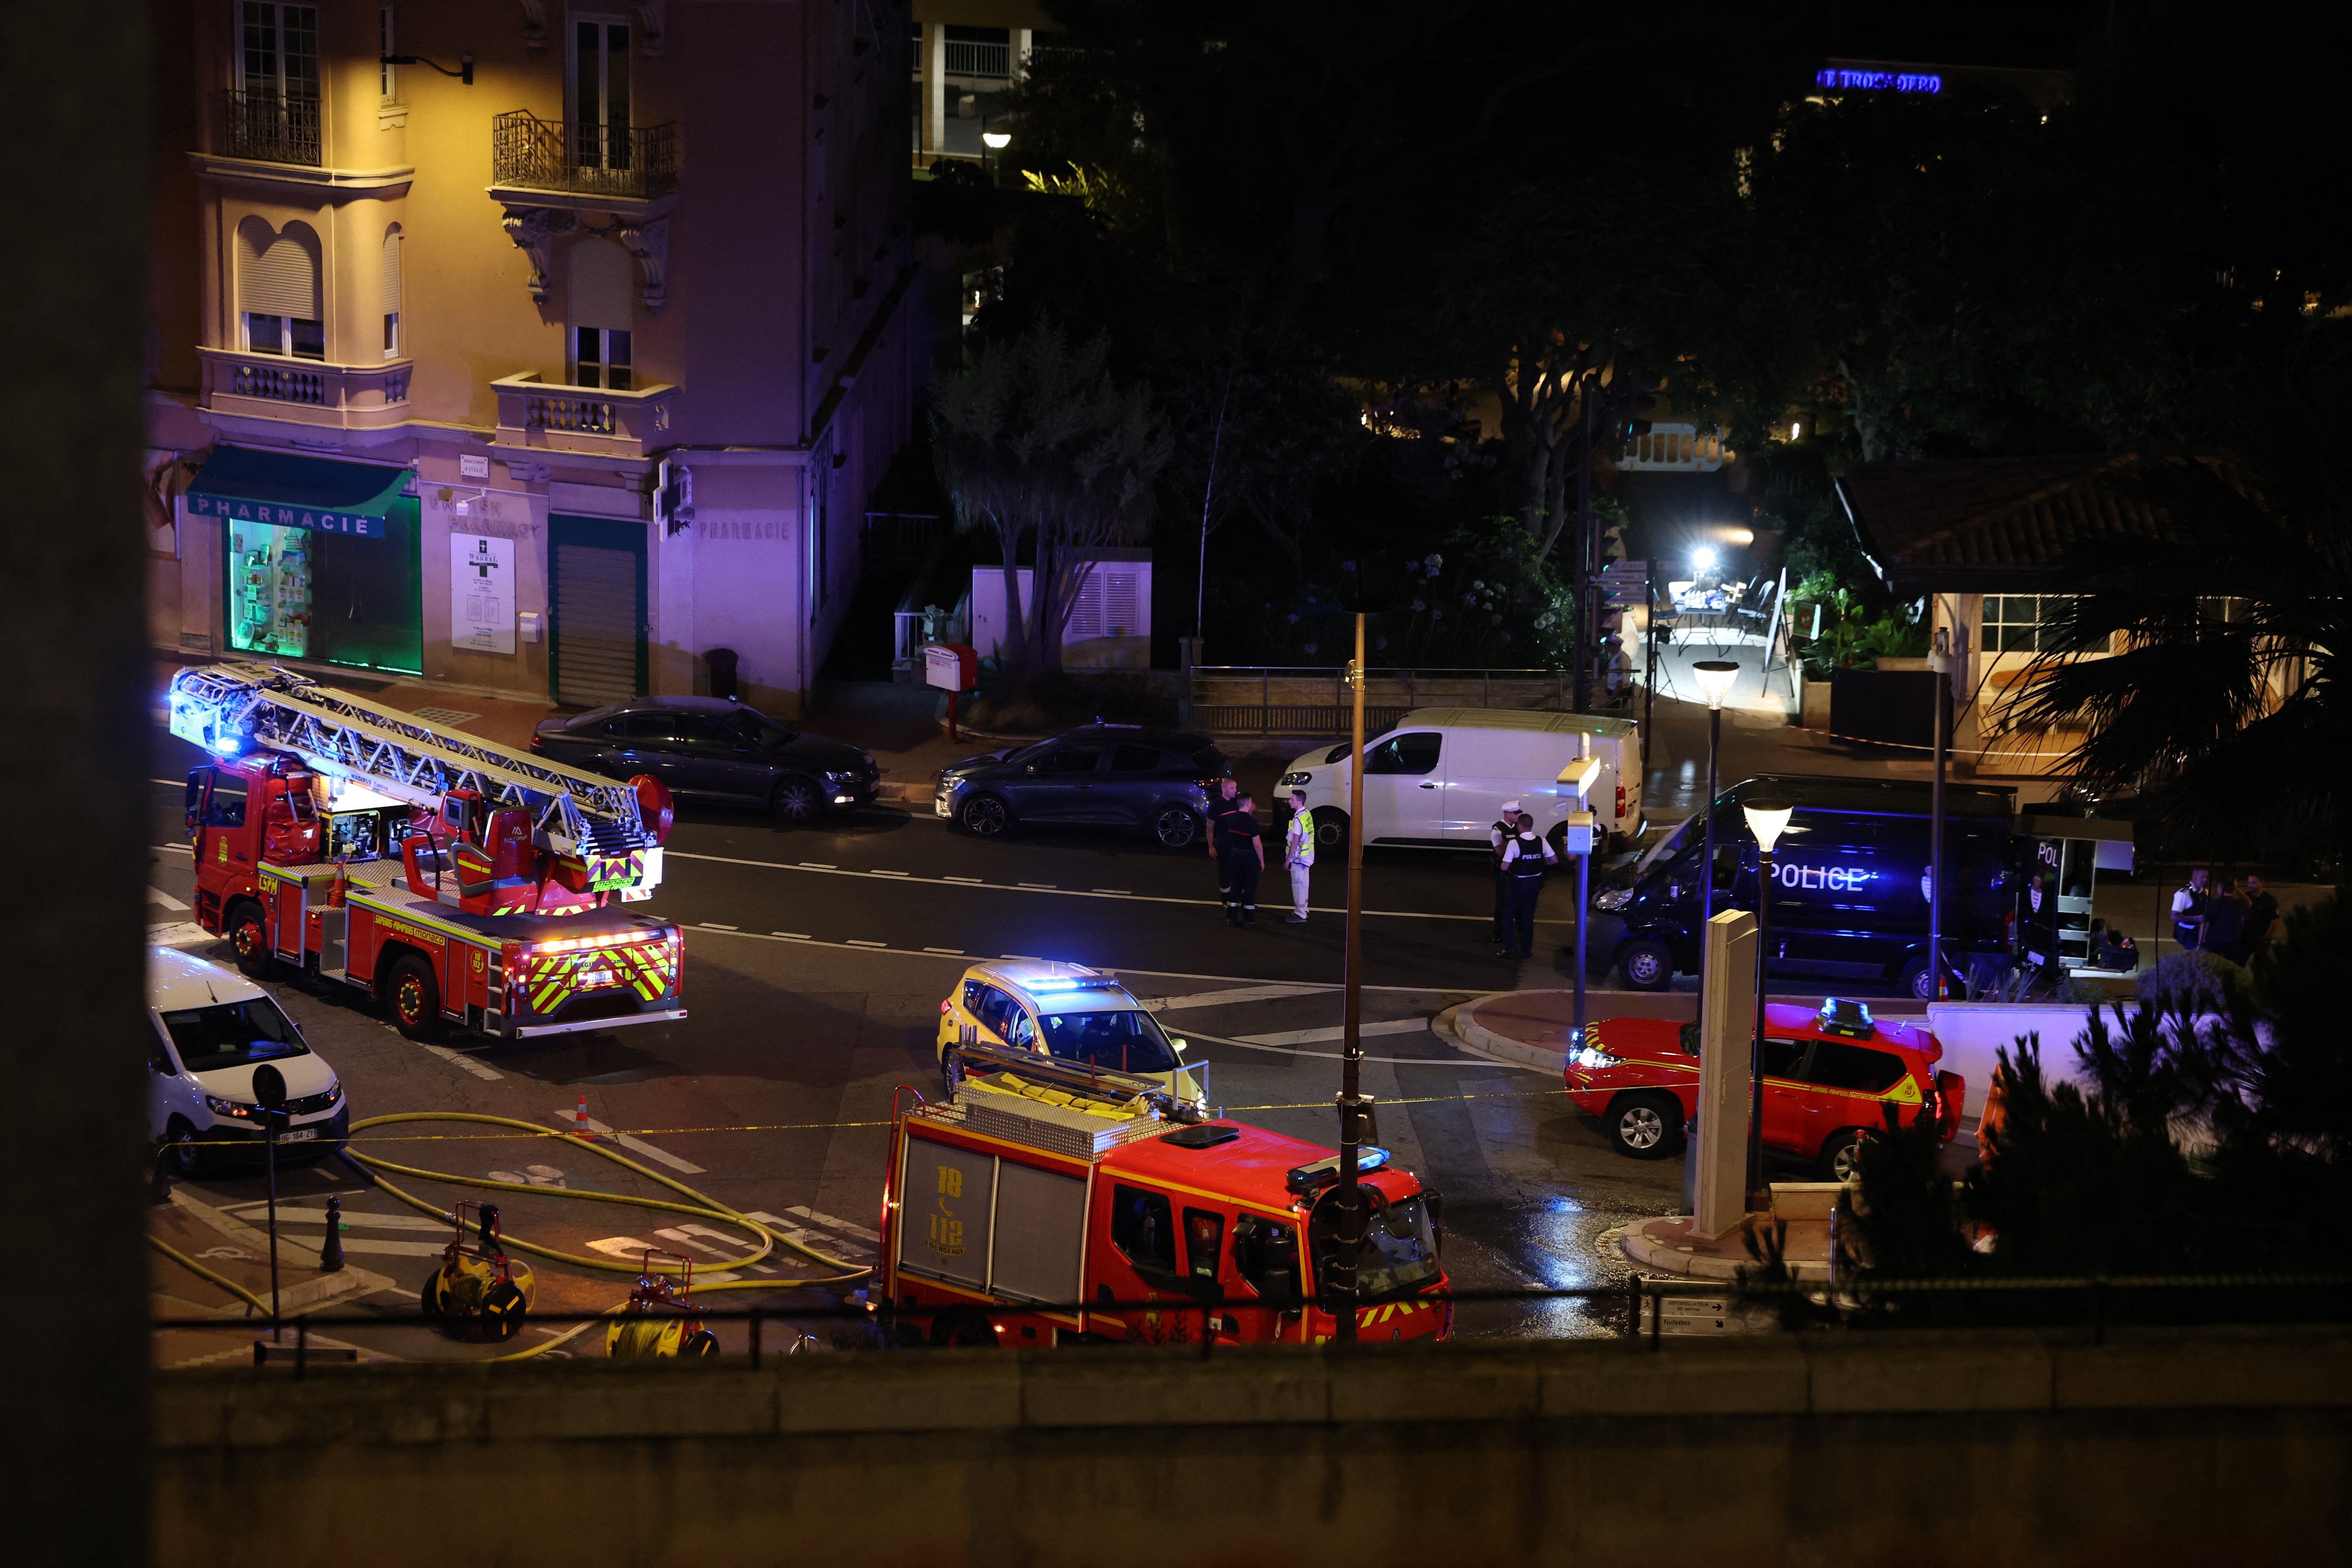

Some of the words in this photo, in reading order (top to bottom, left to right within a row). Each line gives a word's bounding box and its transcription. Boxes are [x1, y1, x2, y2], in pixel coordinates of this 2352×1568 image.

[198, 498, 368, 534] PHARMACIE
[700, 522, 789, 539] PHARMACIE
[351, 774, 372, 785] MAGIRUS
[374, 782, 388, 791] Camiva
[259, 874, 278, 895] CSPM
[415, 929, 444, 945] monaco
[475, 952, 481, 961] 18
[1849, 1092, 1877, 1100] monaco
[938, 1166, 962, 1198] 18
[930, 1213, 963, 1246] 112
[924, 1239, 964, 1255] EMERGENCY
